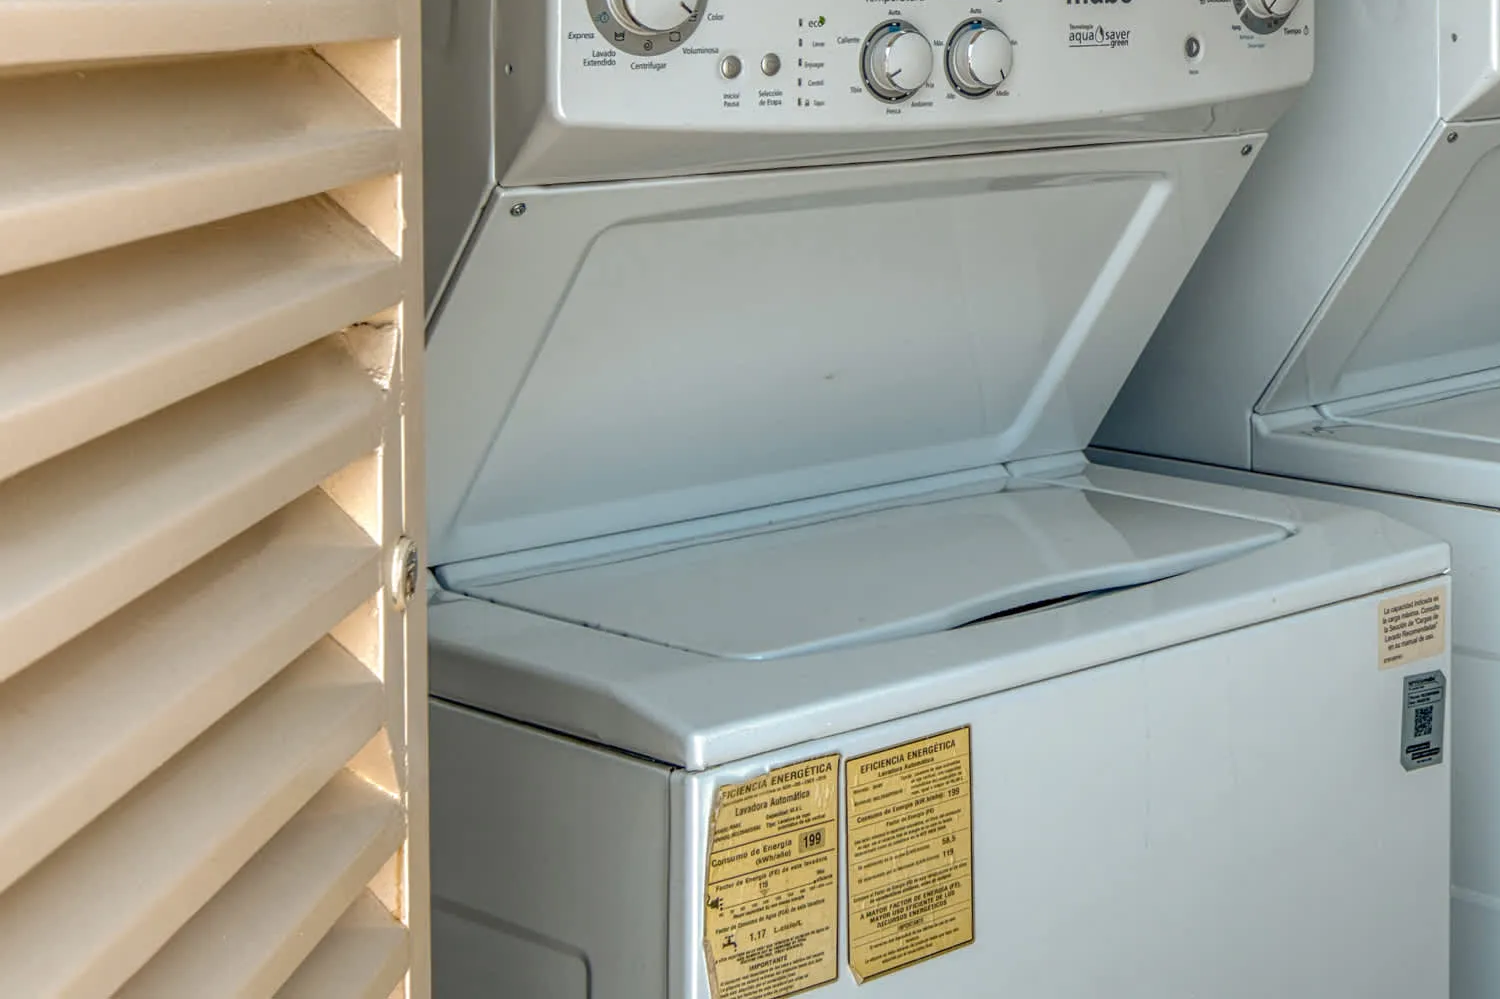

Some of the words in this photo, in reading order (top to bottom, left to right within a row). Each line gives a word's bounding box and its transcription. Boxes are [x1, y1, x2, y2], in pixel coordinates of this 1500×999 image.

[707, 13, 724, 21] Color
[1068, 30, 1094, 44] aqua
[1105, 29, 1131, 41] saver
[1110, 39, 1129, 48] green
[592, 49, 616, 58] Lavado
[682, 46, 719, 55] Voluminosa
[583, 58, 616, 67] Extendido
[630, 61, 667, 71] Centrifugar
[860, 755, 904, 774] EFICIENCIA
[907, 738, 955, 760] ENERGÉTICA
[720, 779, 767, 800] FICIENCIA
[771, 761, 832, 785] ENERGÉTICA
[948, 787, 959, 797] 199
[735, 800, 767, 816] Lavadora
[770, 788, 810, 805] Automática
[803, 832, 821, 848] 199
[711, 850, 748, 867] Consumo
[750, 847, 760, 856] de
[763, 837, 792, 853] Energía
[866, 906, 888, 917] MAYOR
[749, 928, 766, 941] 1.17
